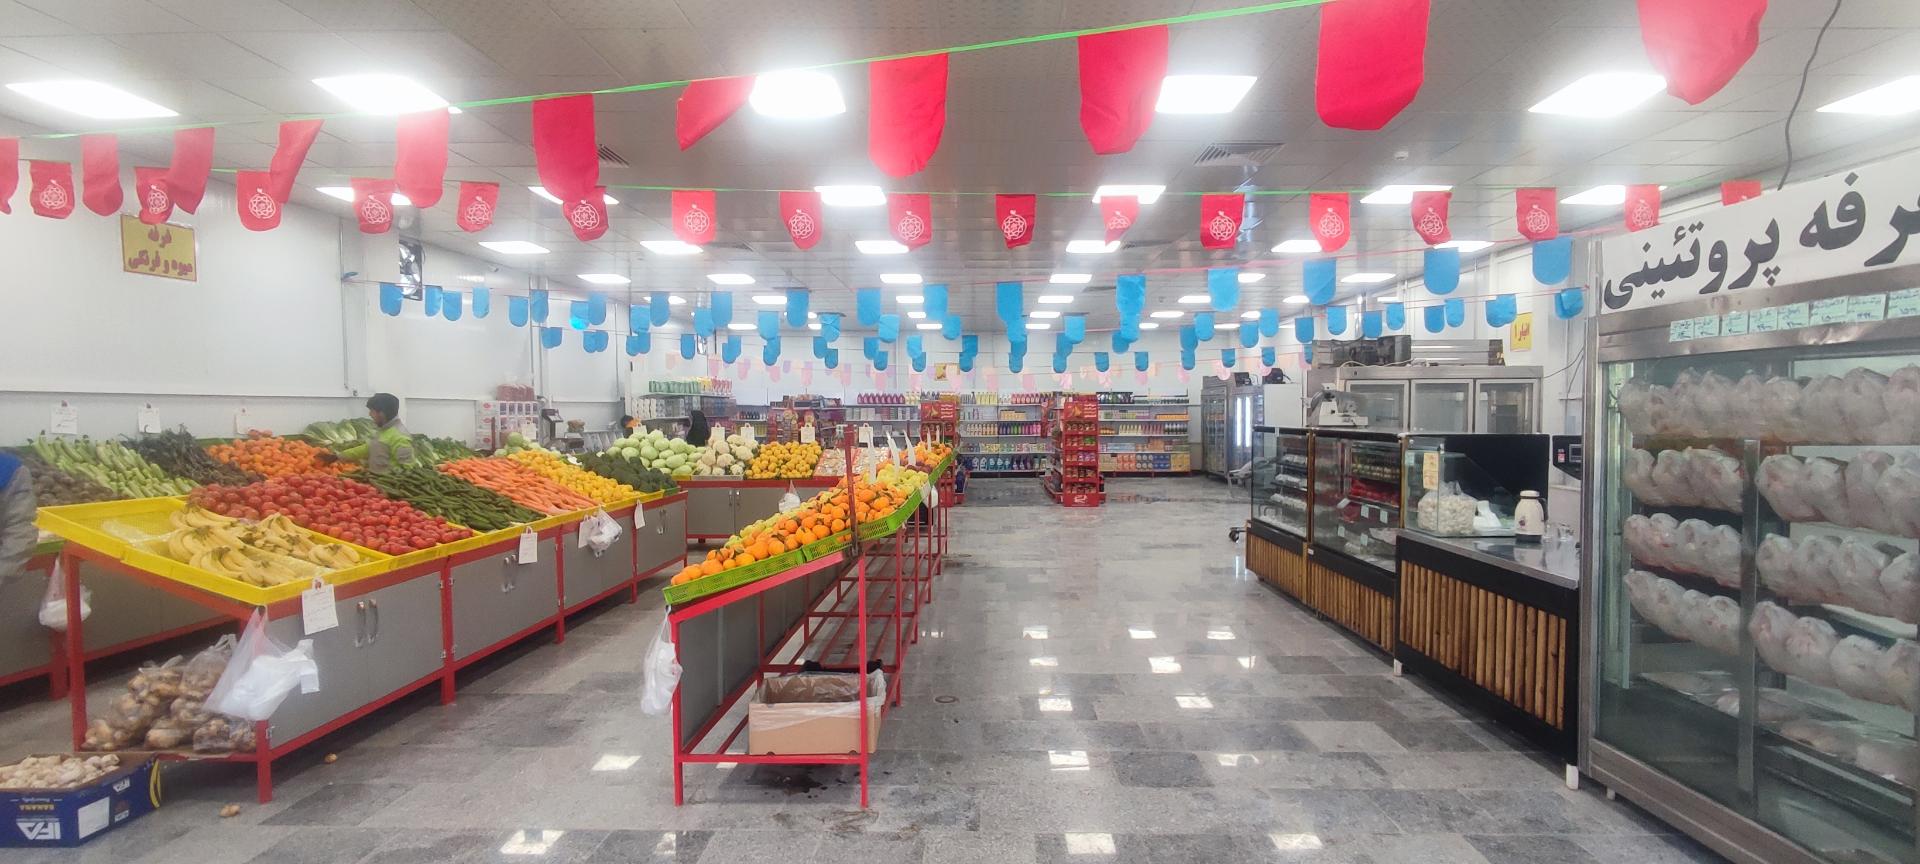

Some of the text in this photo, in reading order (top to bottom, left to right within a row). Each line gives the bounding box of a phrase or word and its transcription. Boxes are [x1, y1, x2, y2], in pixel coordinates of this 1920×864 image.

[1603, 171, 1920, 310] رفه پروتئینی
[162, 259, 170, 275] و
[16, 821, 61, 840] IFA
